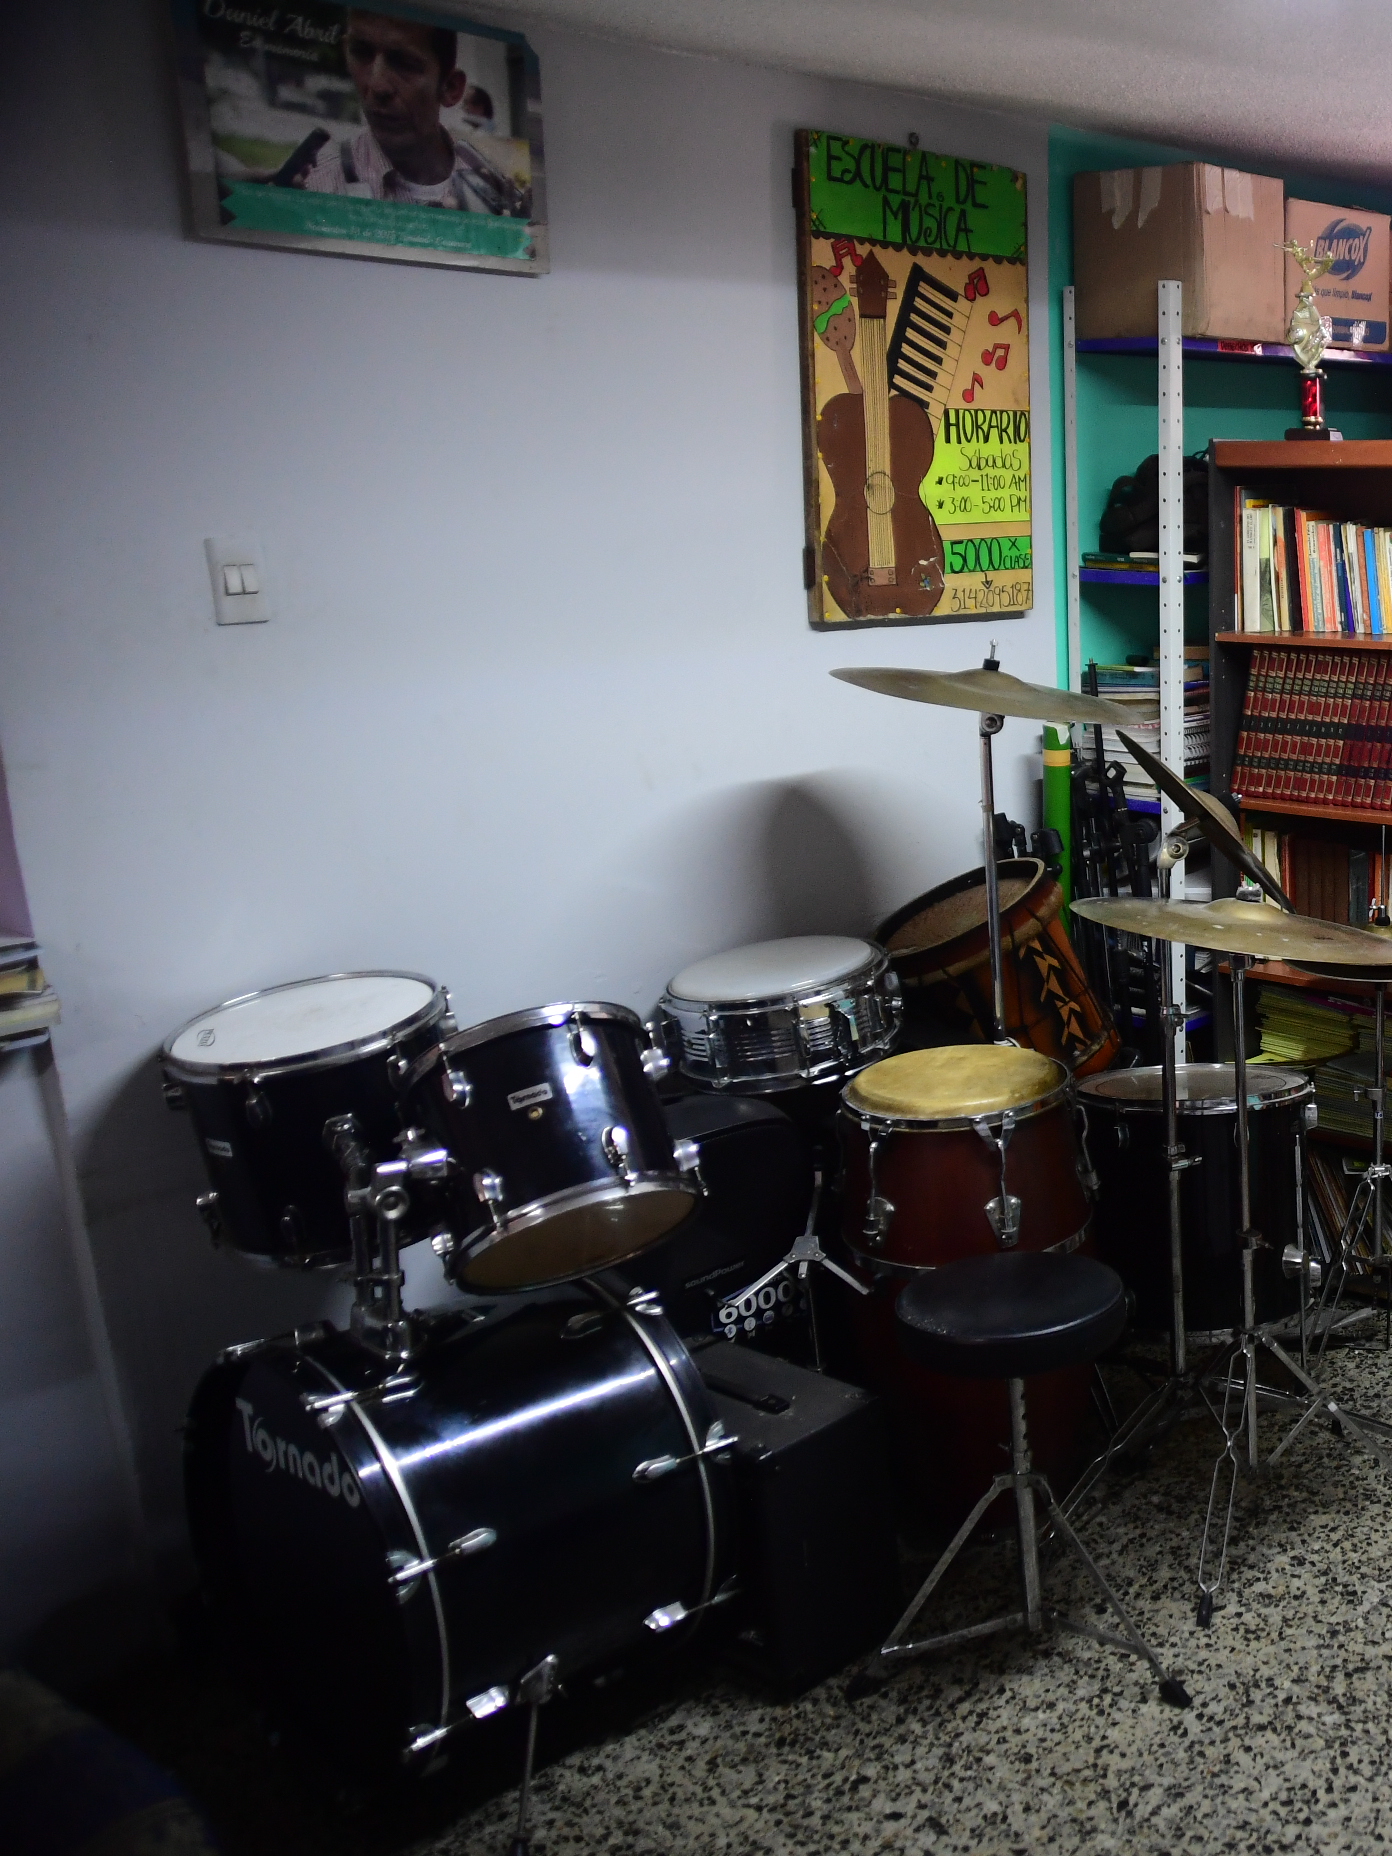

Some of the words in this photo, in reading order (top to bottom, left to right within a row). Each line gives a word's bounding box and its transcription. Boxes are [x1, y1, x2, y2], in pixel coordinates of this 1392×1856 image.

[826, 135, 935, 200] ESCUELA
[954, 158, 989, 209] DE
[882, 192, 974, 252] MÚSICA
[1315, 226, 1373, 267] BLANCOX
[944, 409, 1028, 445] HORARIO
[1008, 473, 1028, 492] AM
[1010, 494, 1028, 514] PM
[950, 537, 1002, 574] 5000
[1003, 553, 1031, 570] CLASE
[951, 581, 1031, 613] 3142095187
[510, 1089, 549, 1104] Tornado
[718, 1280, 794, 1325] 6000
[235, 1397, 362, 1510] Tornado
